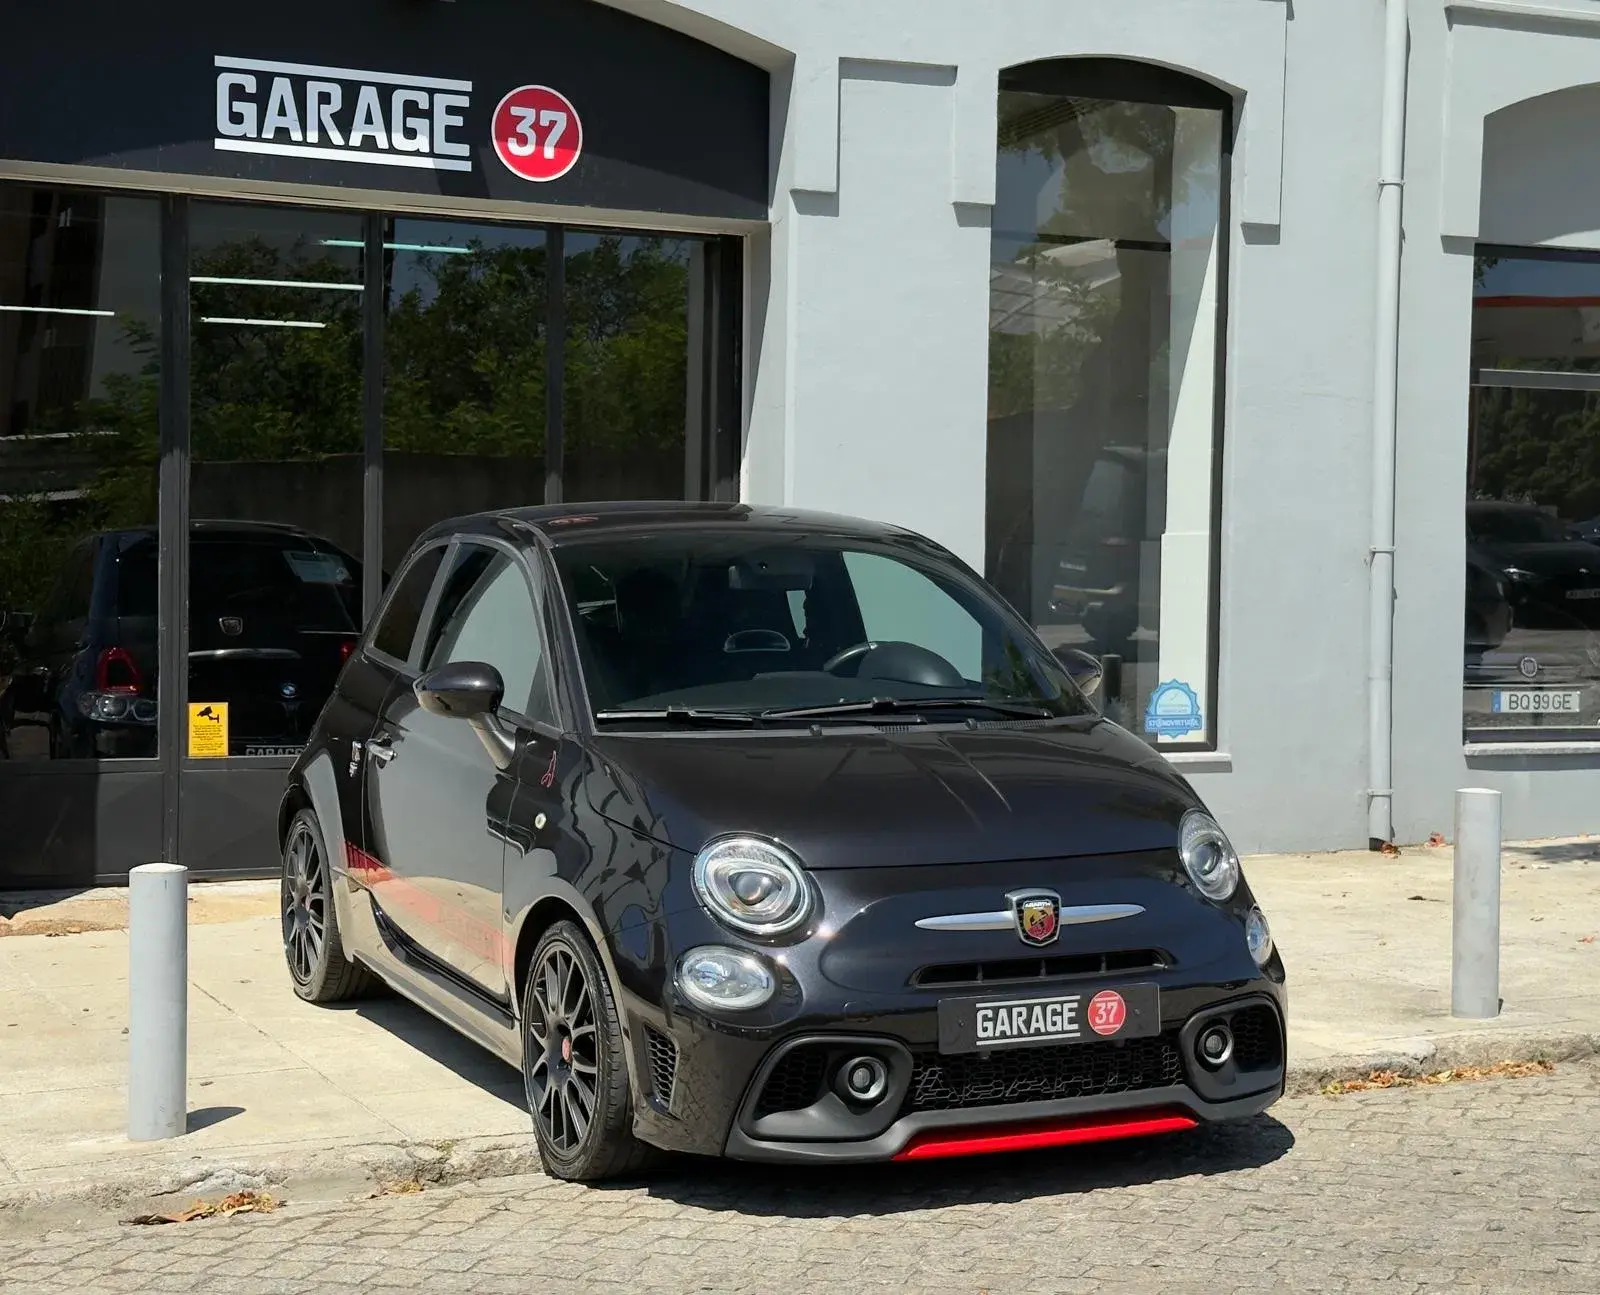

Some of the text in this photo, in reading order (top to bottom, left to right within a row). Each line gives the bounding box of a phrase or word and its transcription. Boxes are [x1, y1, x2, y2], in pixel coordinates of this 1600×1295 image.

[216, 72, 567, 160] GARAGE 37
[976, 1002, 1118, 1038] GARAGE 37
